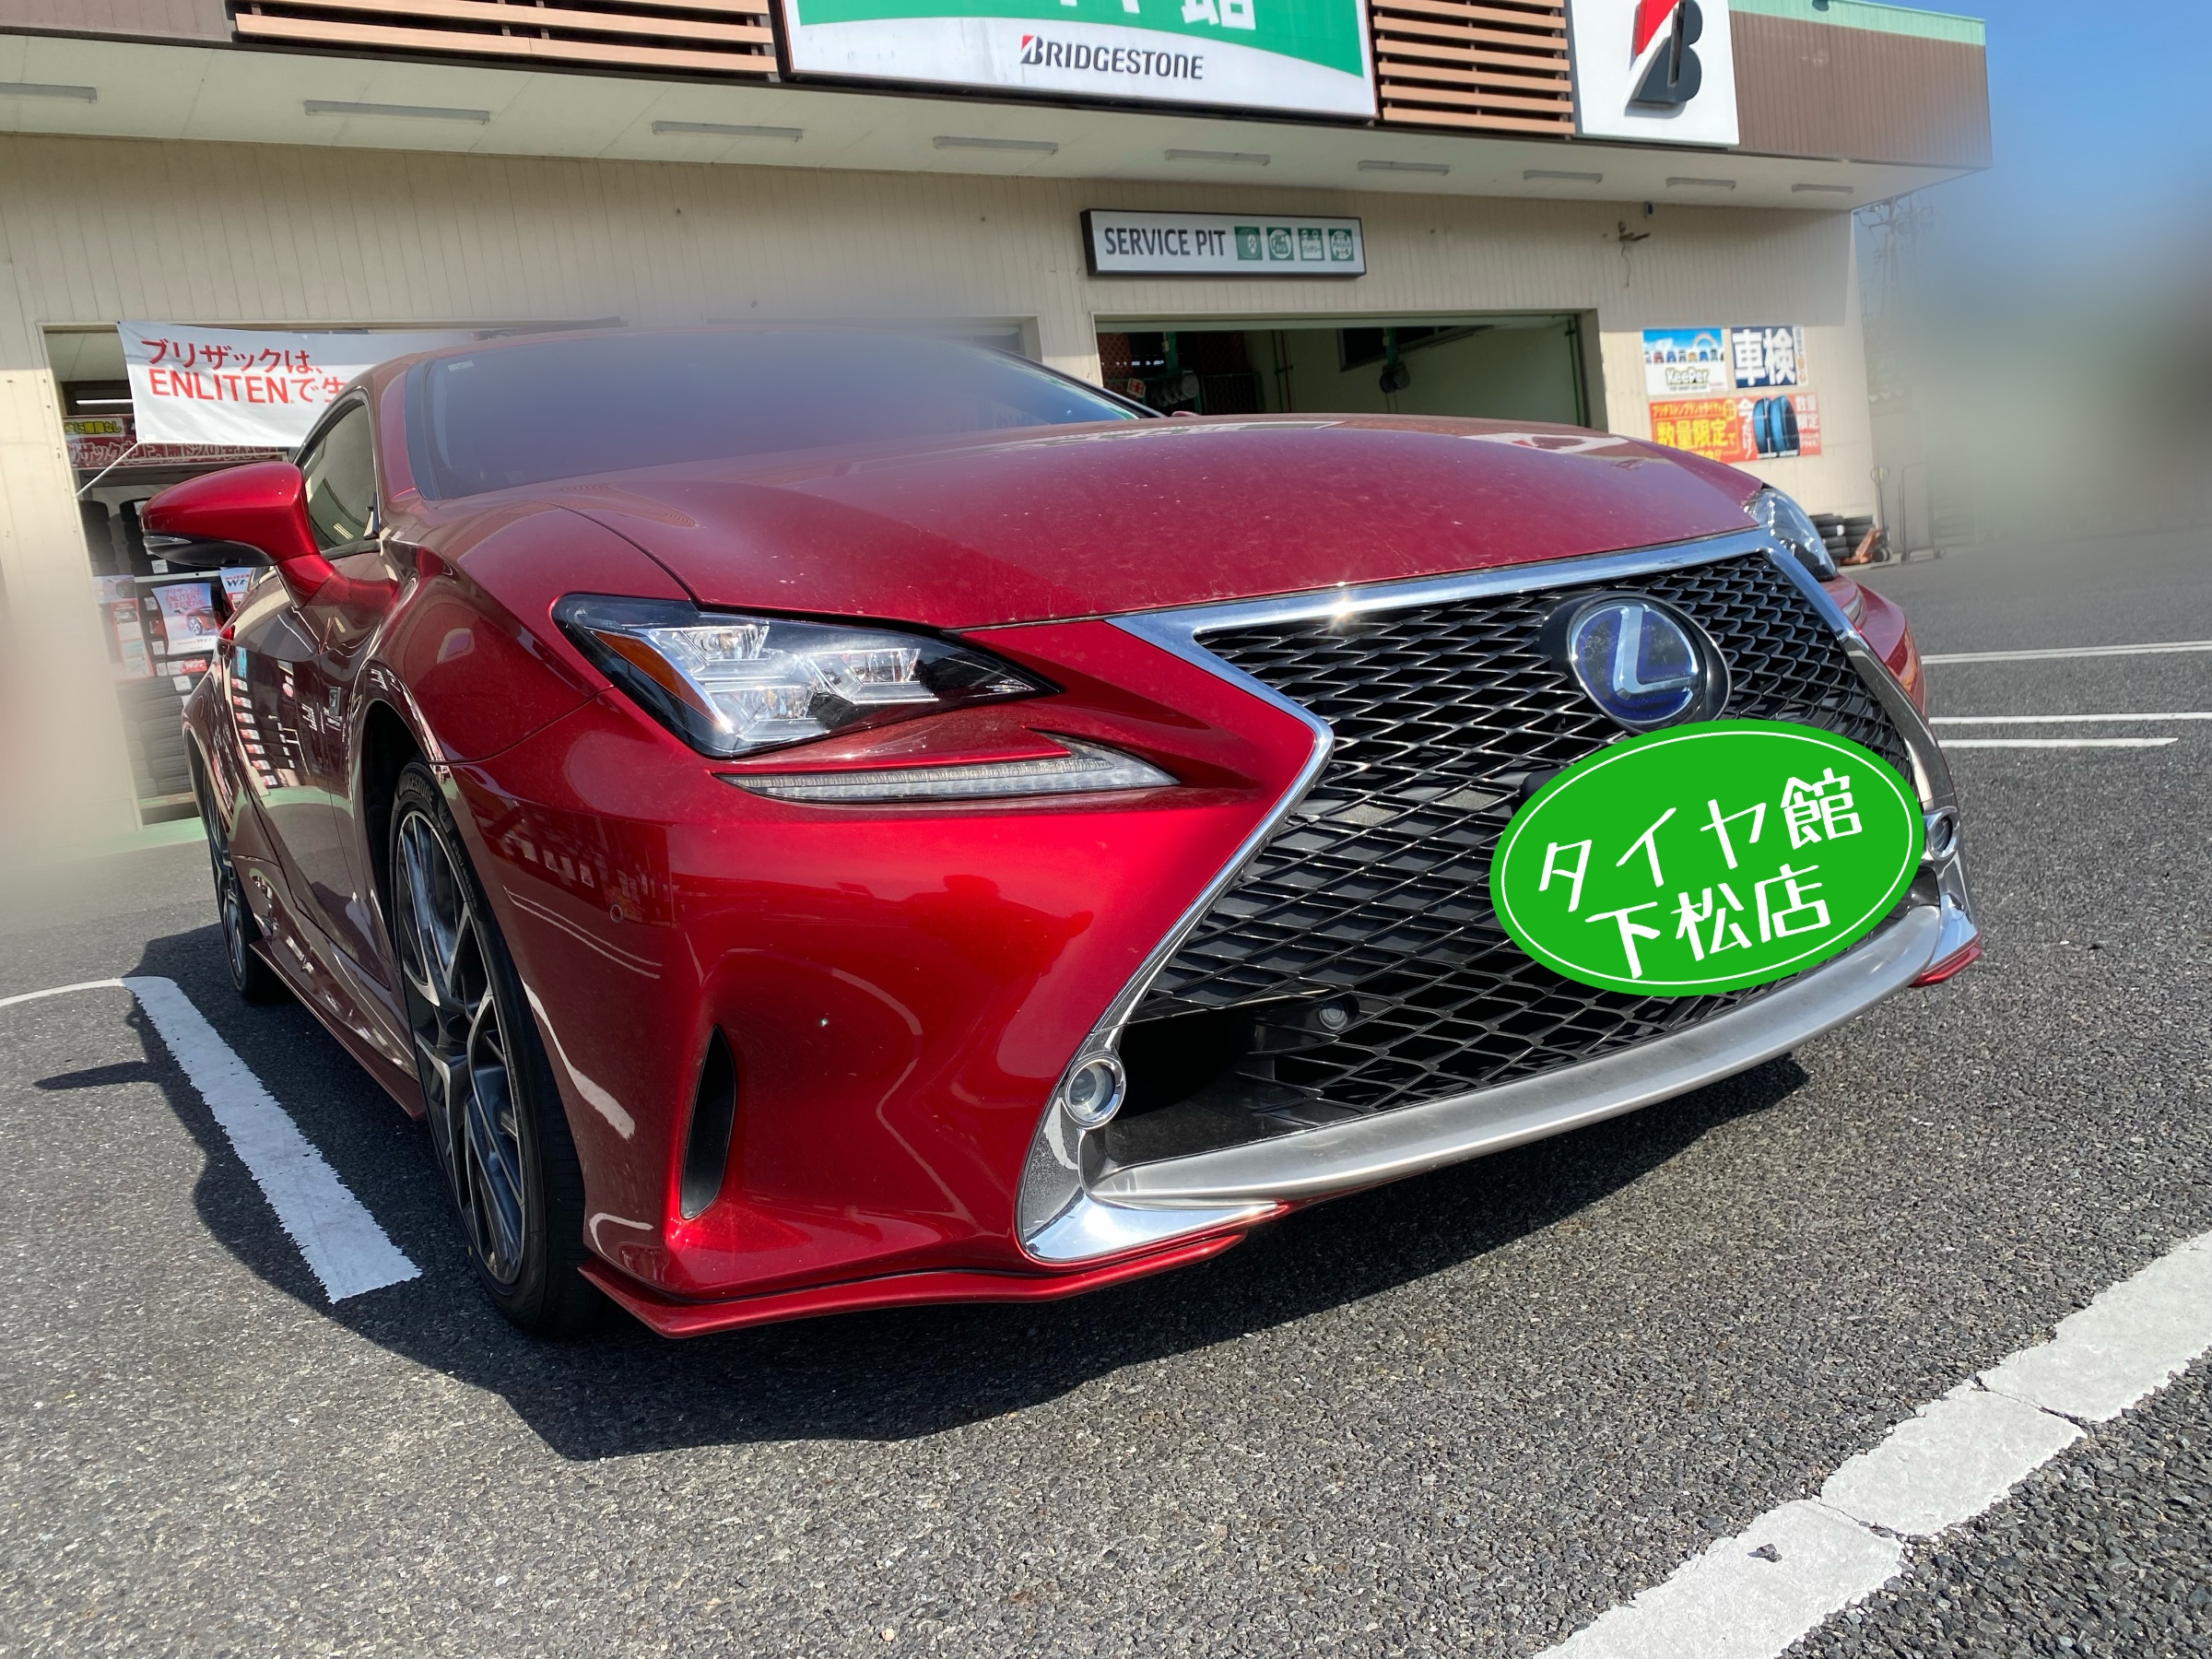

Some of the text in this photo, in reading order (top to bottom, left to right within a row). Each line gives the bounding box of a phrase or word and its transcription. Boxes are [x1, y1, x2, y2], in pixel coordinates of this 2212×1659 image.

[1019, 34, 1204, 80] BRIDGESTONE
[1104, 227, 1226, 257] SERVICE PIT
[1733, 329, 1795, 386] 車検
